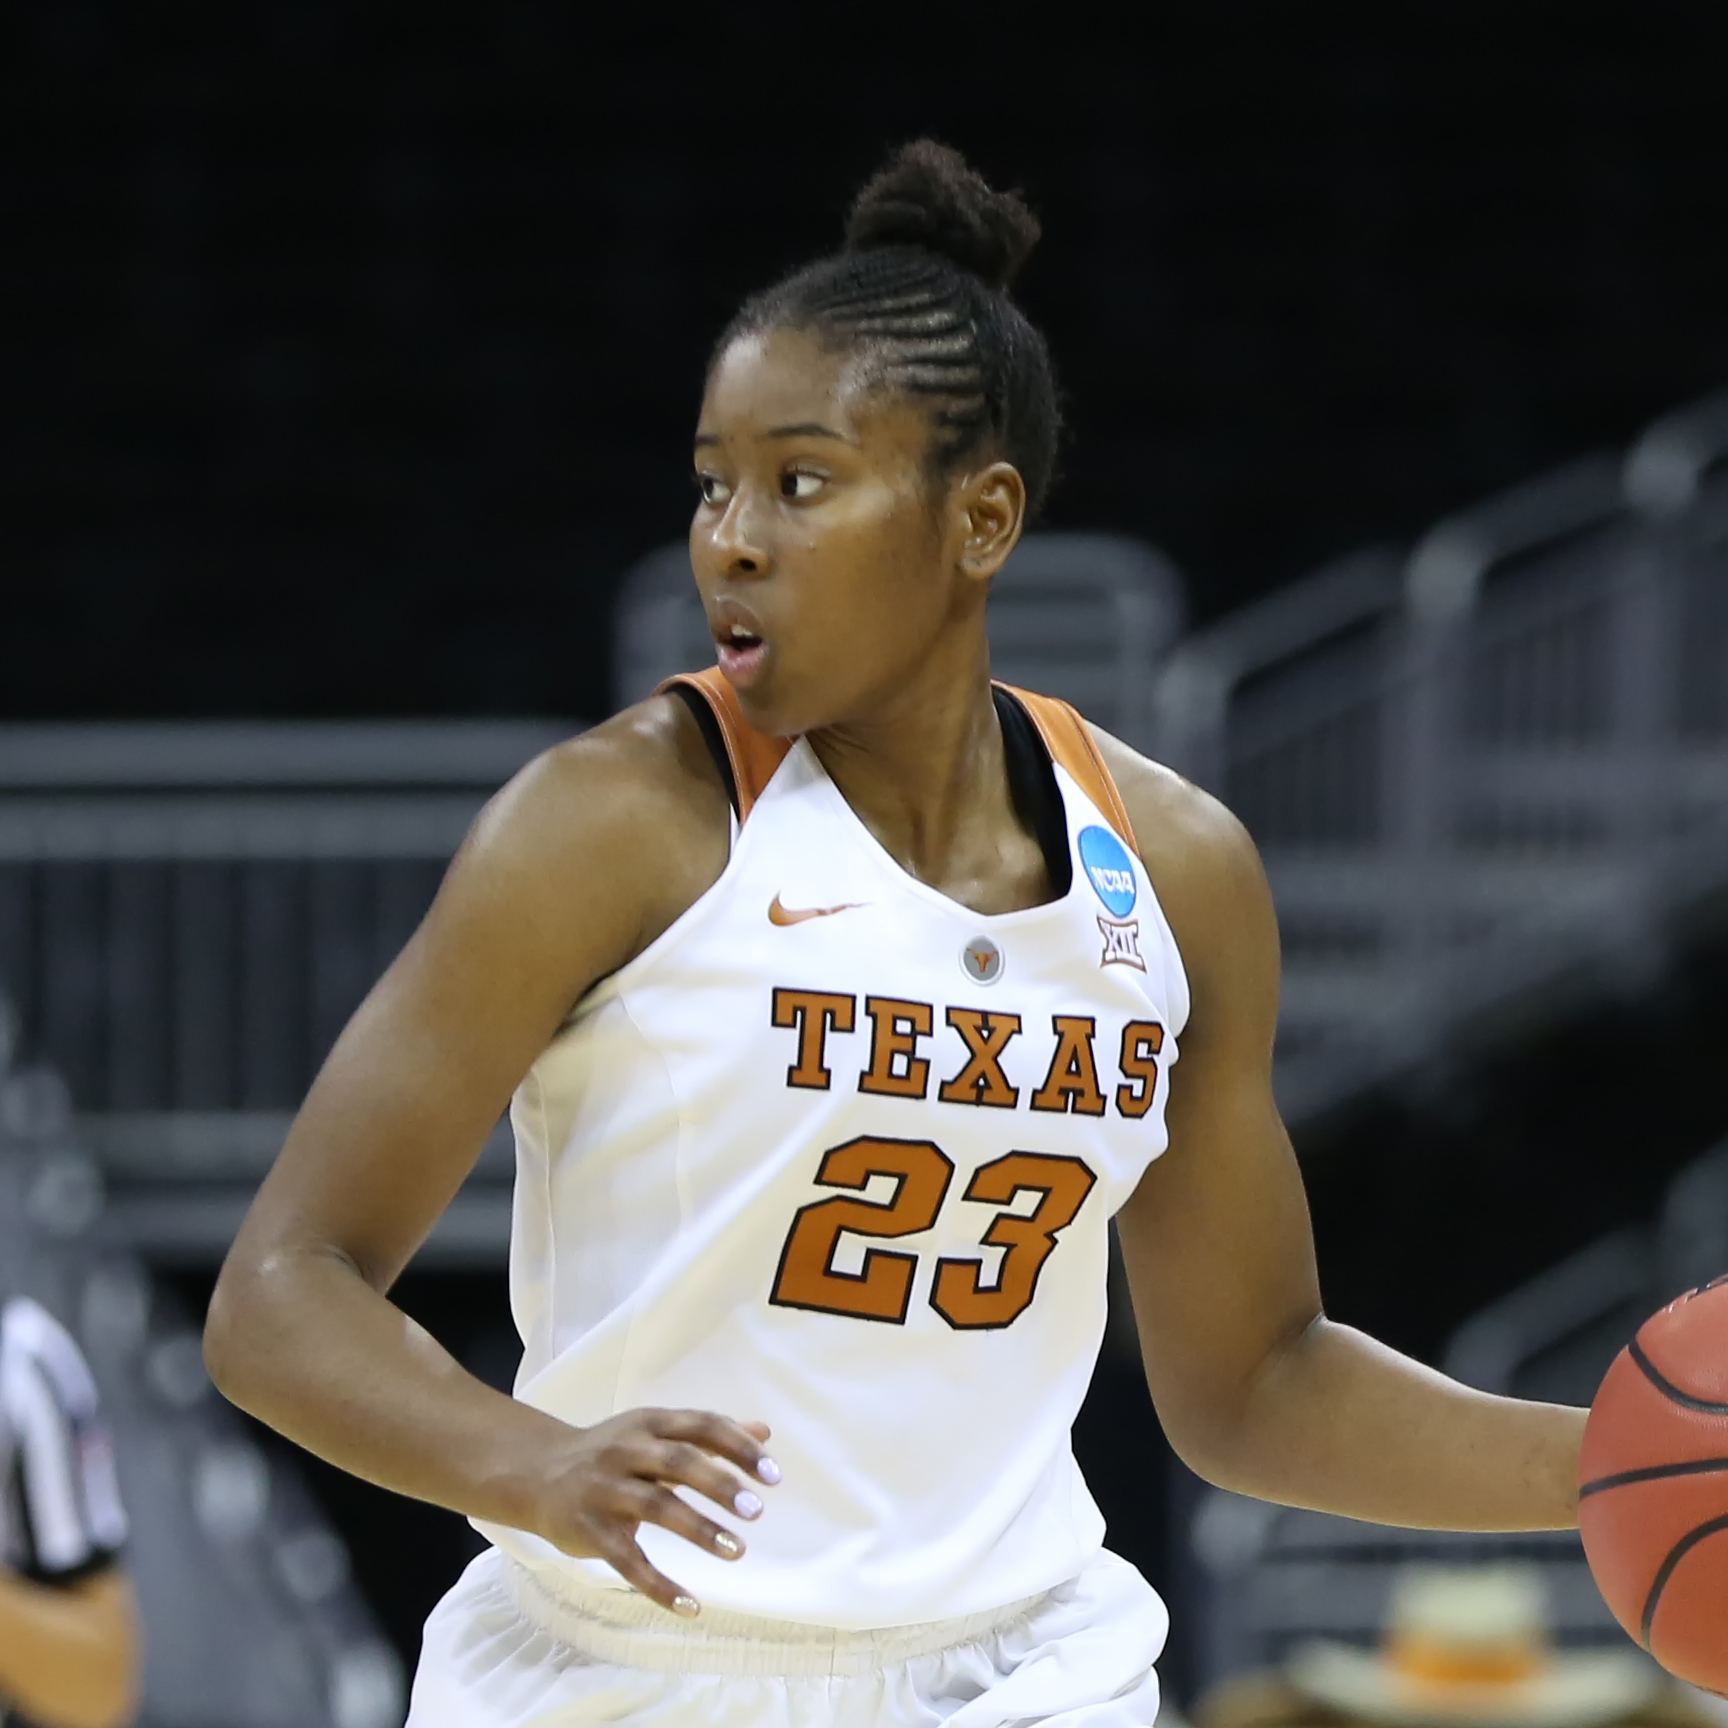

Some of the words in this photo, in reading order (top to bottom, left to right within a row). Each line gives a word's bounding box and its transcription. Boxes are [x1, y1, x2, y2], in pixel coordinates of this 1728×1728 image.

[1090, 866, 1135, 895] NCAA
[771, 986, 1166, 1120] TEXAS
[768, 1134, 1098, 1331] 23
